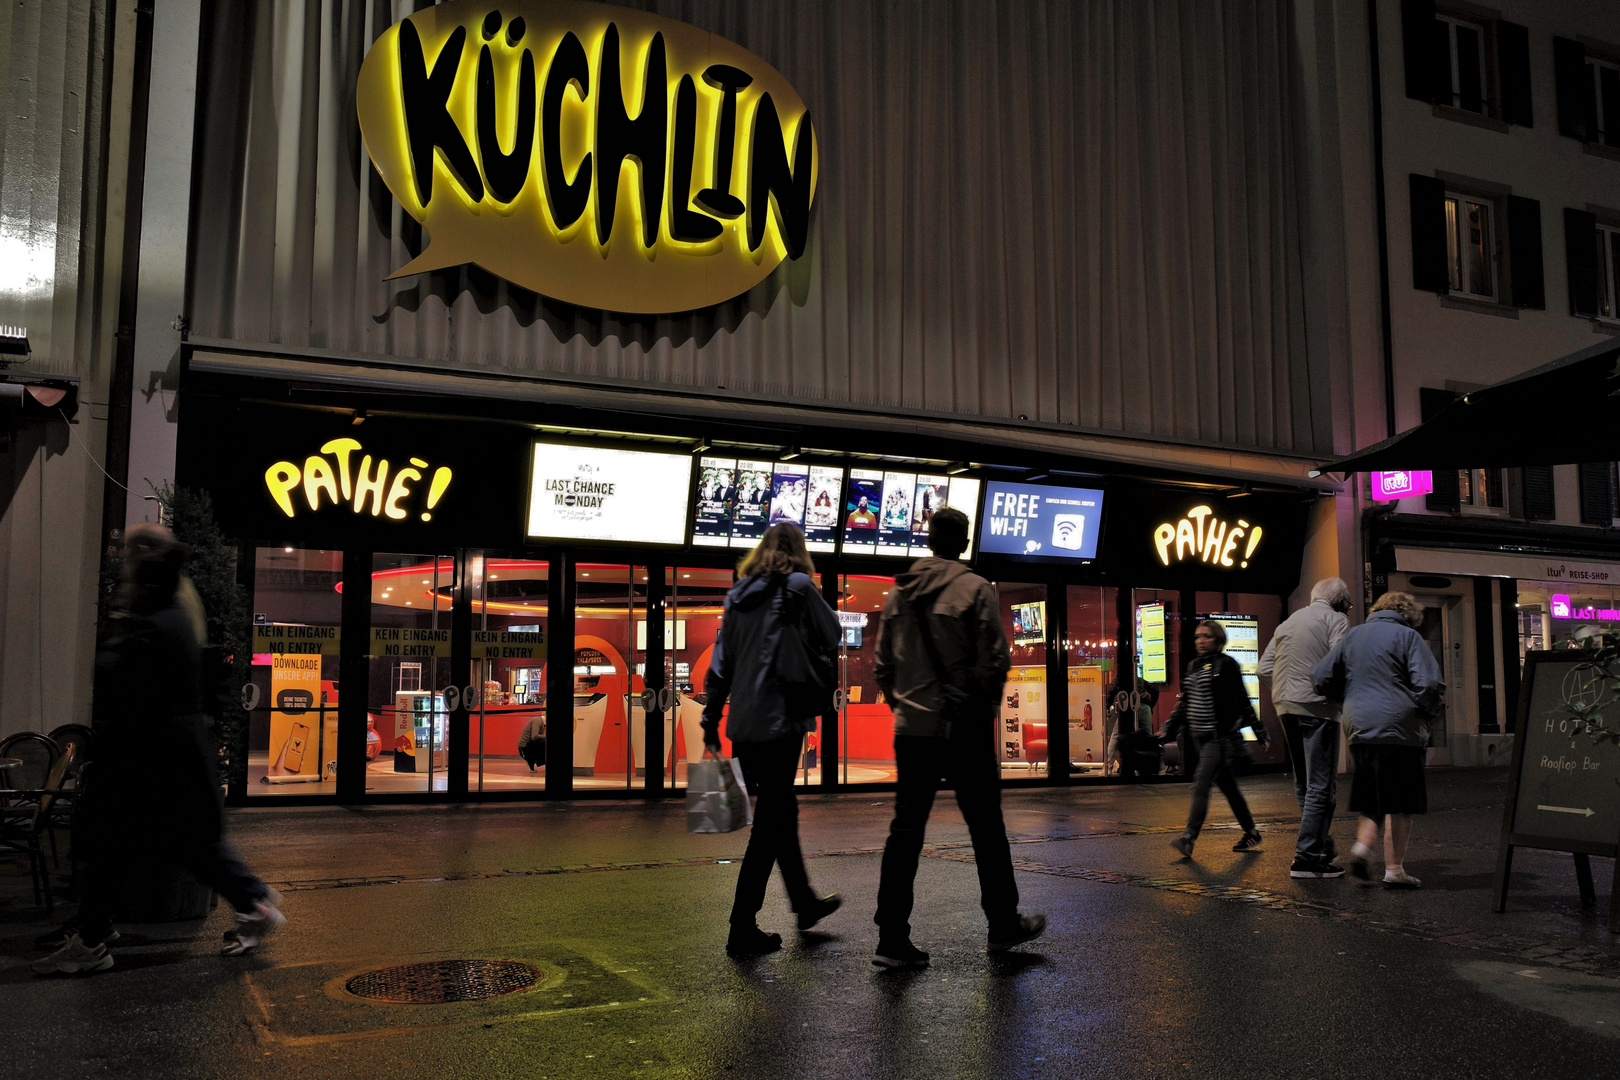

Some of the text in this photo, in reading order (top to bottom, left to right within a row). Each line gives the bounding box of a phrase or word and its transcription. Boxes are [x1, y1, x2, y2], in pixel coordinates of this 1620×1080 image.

[399, 10, 812, 261] KÜCHLIN
[546, 478, 615, 495] LAST CHANCE
[555, 494, 604, 508] MONDAY
[992, 492, 1040, 518] FREE
[990, 517, 1028, 537] WI-FI
[1376, 575, 1385, 584] 65
[1569, 570, 1609, 580] REISE-SHOP
[1572, 608, 1596, 620] LAST
[258, 626, 335, 638] KEIN EINGANG
[375, 629, 448, 641] KEIN EINGANG
[475, 631, 544, 644] KEIN EINGANG
[269, 642, 322, 654] NO ENTRY
[385, 645, 436, 656] NO ENTRY
[486, 647, 533, 658] NO ENTRY
[274, 658, 318, 670] DOWNLOADE
[273, 669, 319, 681] UNSERE APP!
[400, 698, 408, 713] Bull
[1583, 757, 1600, 771] Bar
